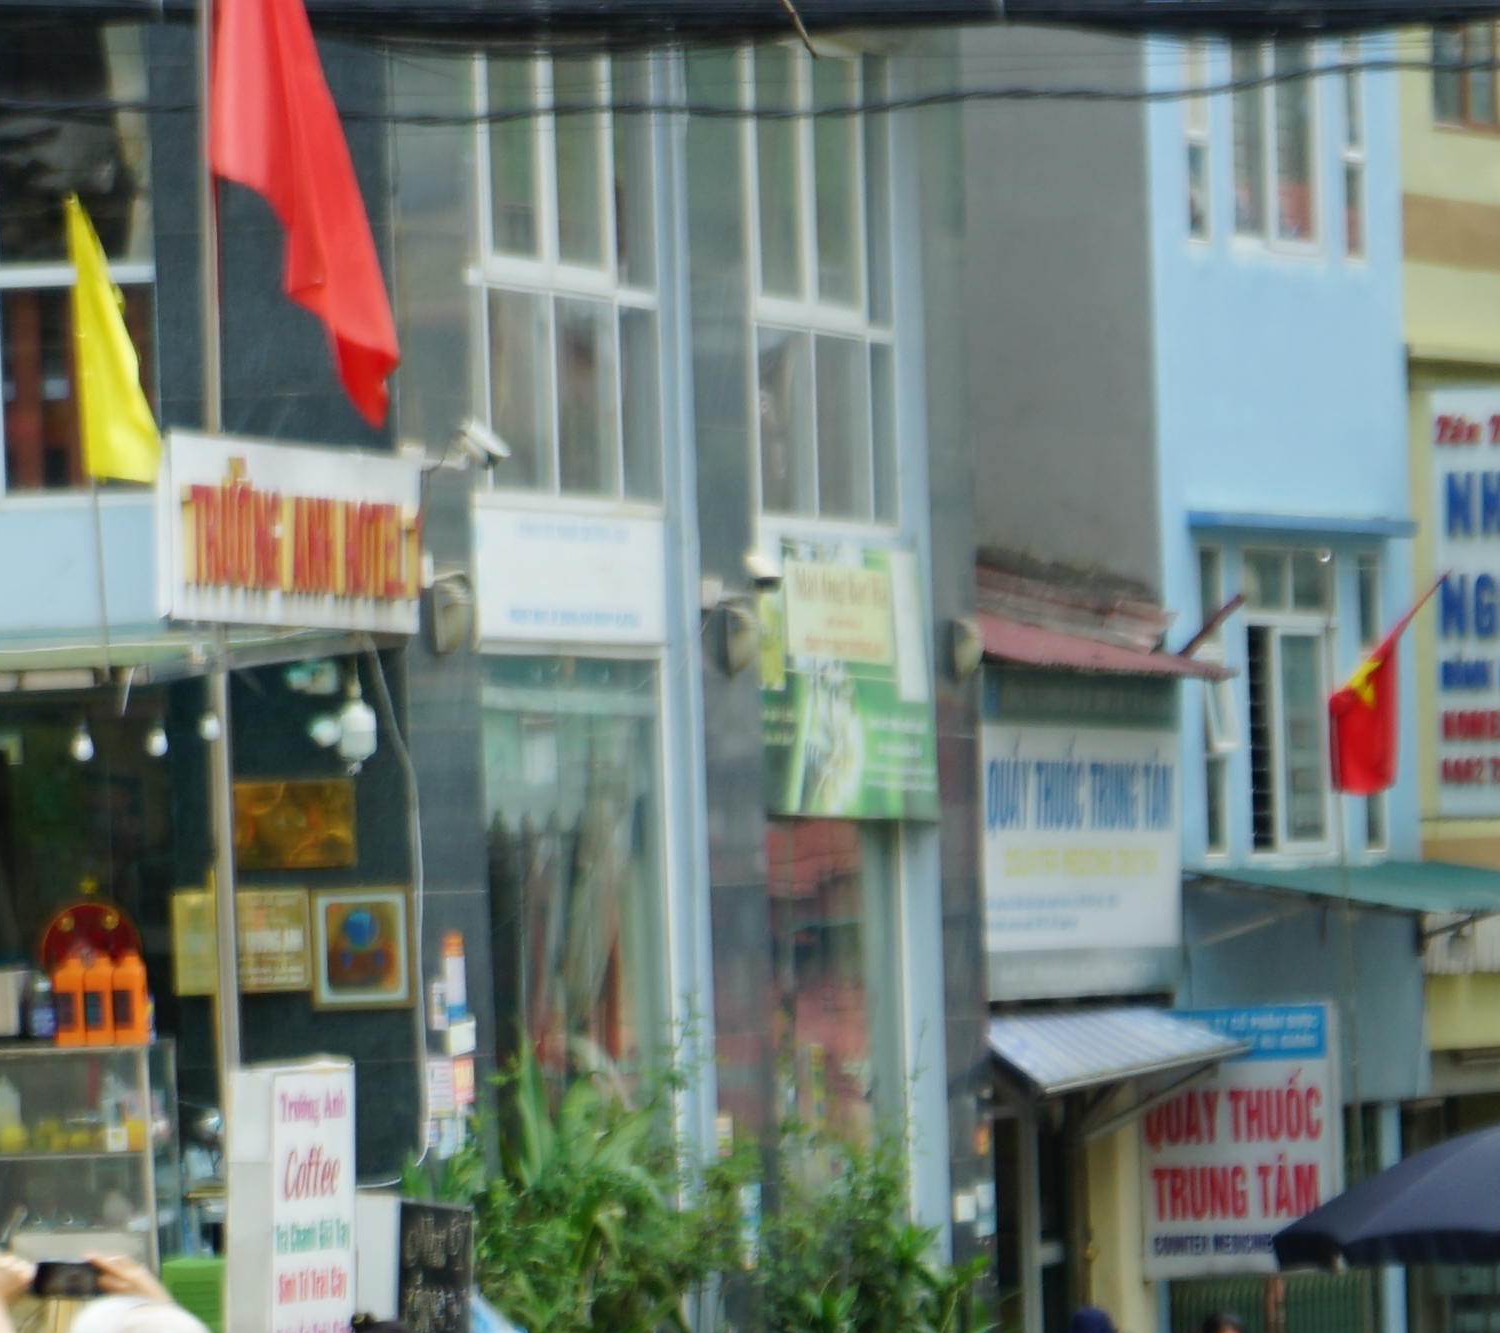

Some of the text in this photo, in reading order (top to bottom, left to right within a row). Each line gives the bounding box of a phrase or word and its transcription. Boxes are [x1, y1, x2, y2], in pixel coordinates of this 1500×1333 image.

[1228, 1066, 1323, 1143] THUỐC
[283, 1147, 341, 1203] Coffee
[1153, 1151, 1321, 1222] TRUNG TÂM
